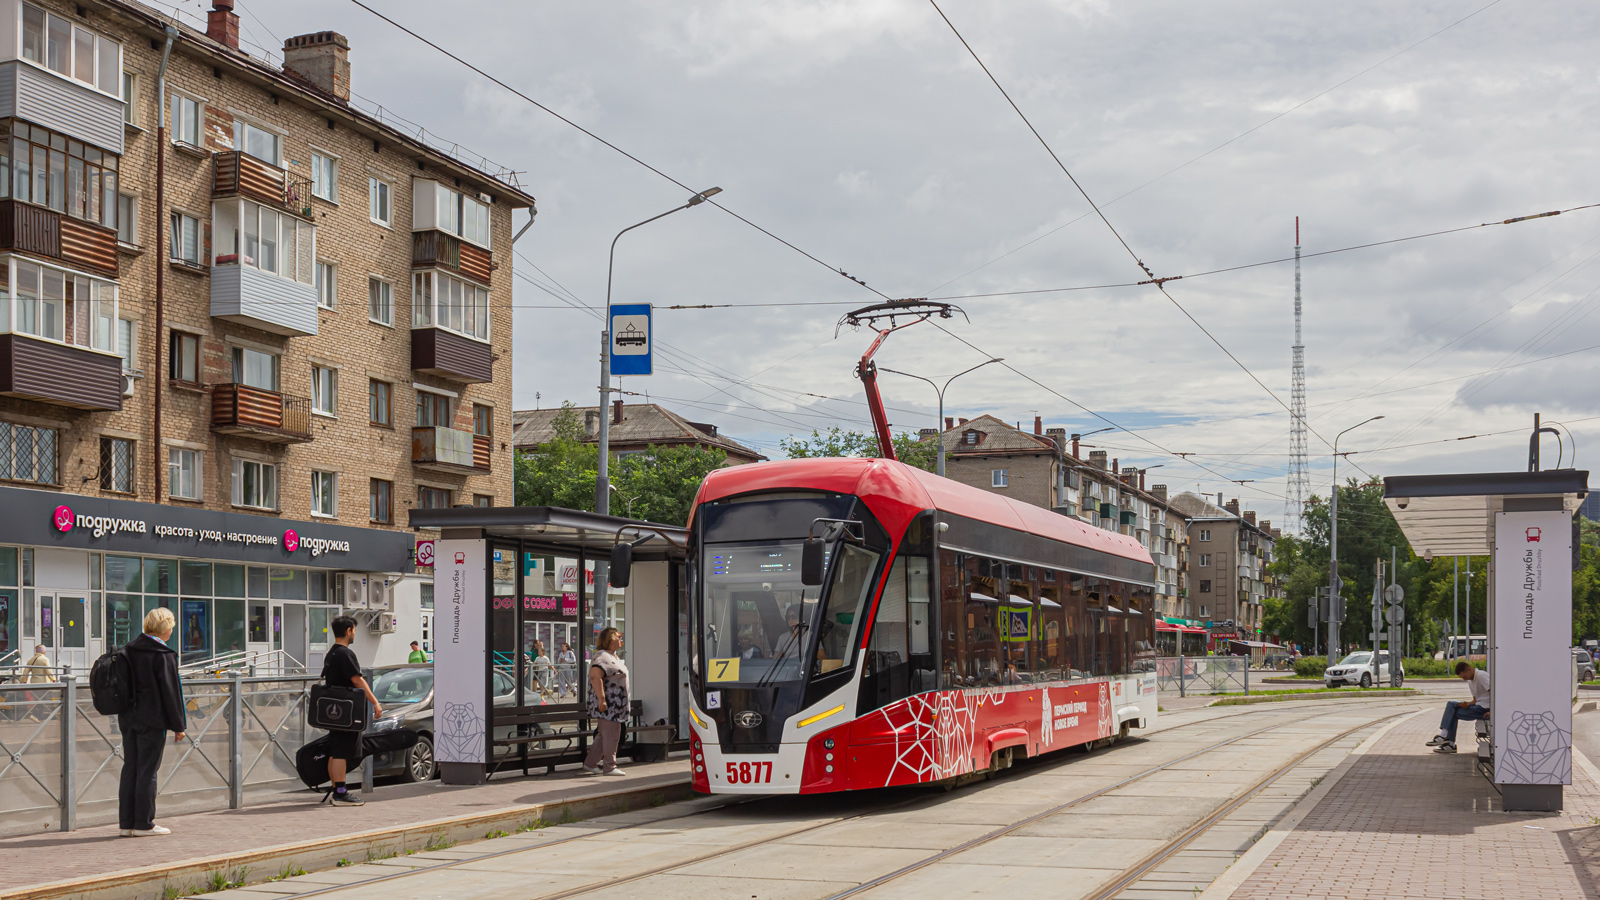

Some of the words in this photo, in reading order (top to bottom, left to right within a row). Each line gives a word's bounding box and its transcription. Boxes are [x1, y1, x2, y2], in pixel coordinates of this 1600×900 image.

[76, 514, 147, 538] подружка
[155, 524, 194, 538] красота
[199, 529, 222, 542] уход
[227, 532, 278, 546] настроение
[299, 536, 350, 558] подружка
[1523, 549, 1536, 591] Дружбы
[452, 569, 461, 604] Дружбы
[494, 597, 515, 609] ОФ
[530, 597, 557, 610] СОБОЙ
[452, 605, 461, 644] Площадь
[1523, 593, 1534, 639] Площадь
[715, 660, 730, 680] 7
[1054, 701, 1073, 717] ПЕРМСКИЙ
[1073, 701, 1087, 714] ПЕРИОД
[725, 761, 773, 785] 5877
